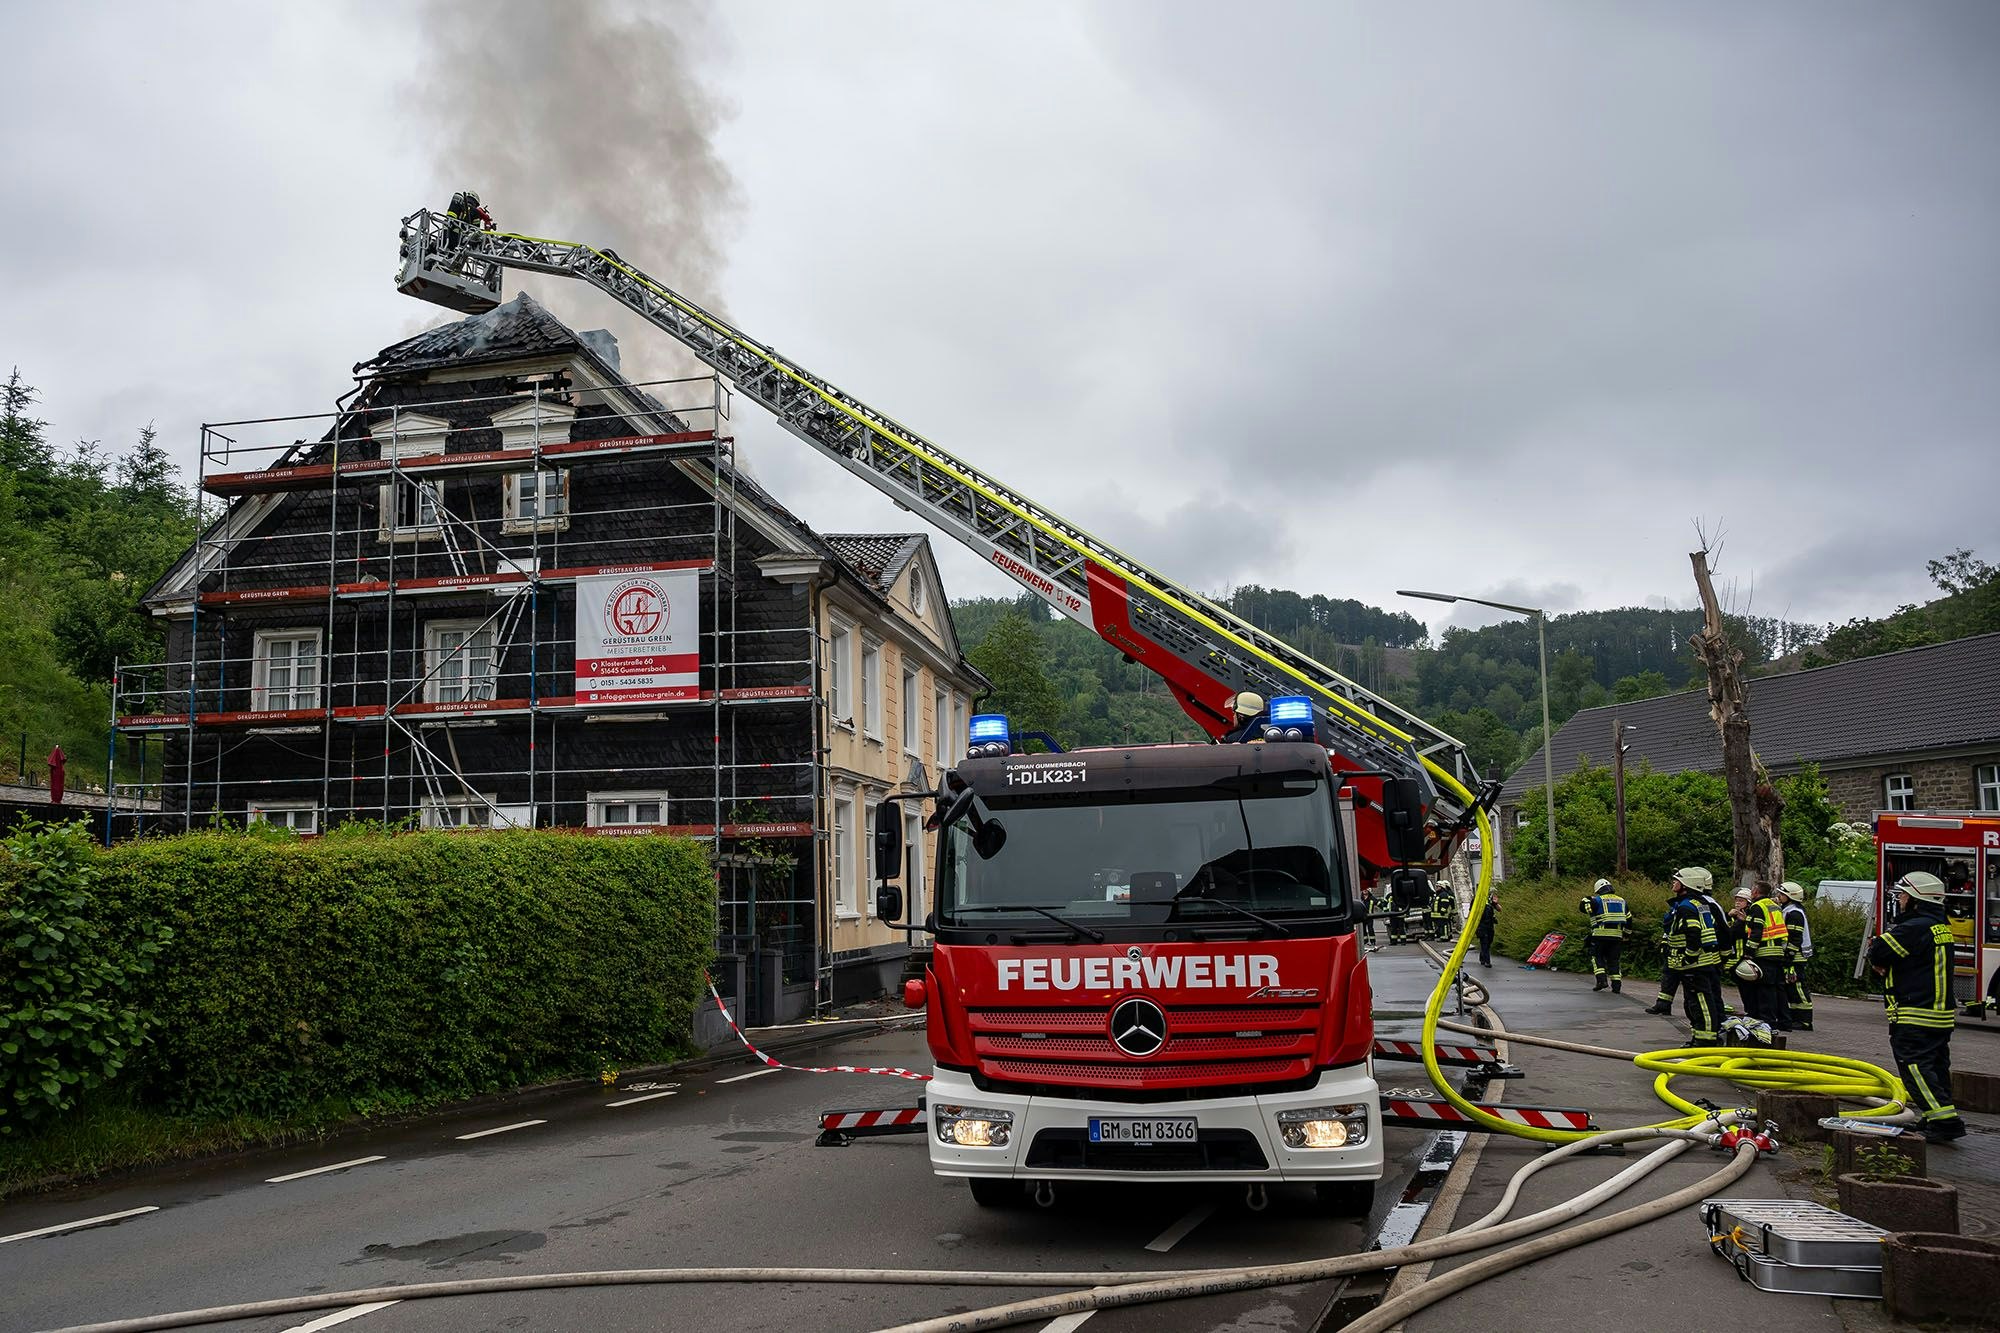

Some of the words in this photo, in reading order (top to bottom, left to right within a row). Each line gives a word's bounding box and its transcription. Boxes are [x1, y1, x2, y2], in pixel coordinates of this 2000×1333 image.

[600, 438, 634, 448] GERÜSTBAU
[635, 437, 654, 445] GREIN
[992, 550, 1054, 595] FEUERWEHR
[1065, 595, 1082, 612] 112
[602, 636, 646, 645] GERÜSTBAU
[606, 646, 667, 654] MEISTERBETRIEB
[600, 659, 643, 667] Klosterstraße
[620, 666, 666, 674] Gummersbach
[1006, 763, 1035, 771] FLORIAN
[1035, 761, 1086, 769] GUMMERSBACH
[1006, 769, 1086, 785] 1-DLK23-1
[997, 955, 1281, 991] FEUERWEHR
[1101, 1122, 1120, 1139] GM
[1132, 1122, 1151, 1139] GM
[1155, 1122, 1194, 1139] 8366
[1068, 1300, 1086, 1311] DIN
